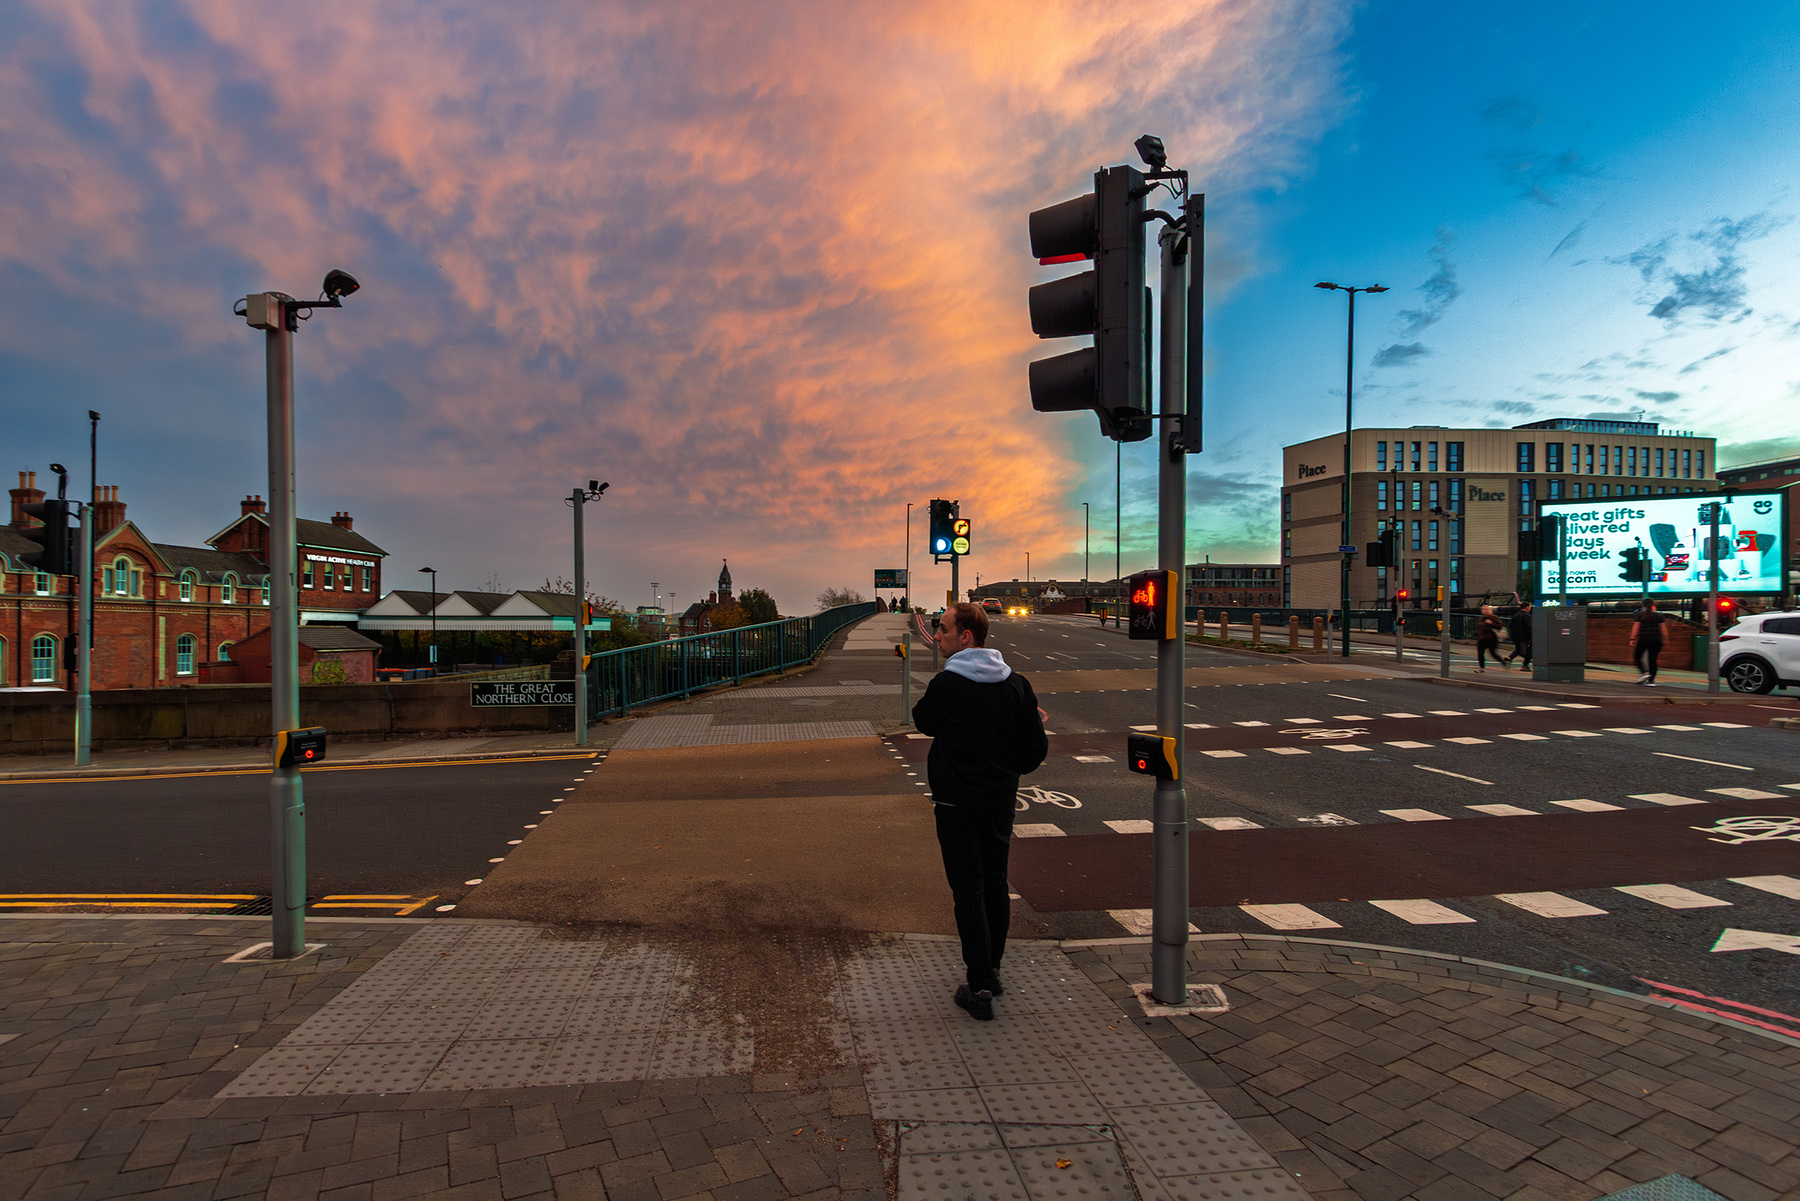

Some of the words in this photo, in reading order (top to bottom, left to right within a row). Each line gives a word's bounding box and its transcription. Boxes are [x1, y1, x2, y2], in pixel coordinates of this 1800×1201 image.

[1298, 465, 1327, 479] Place
[1469, 486, 1506, 501] Place
[1602, 507, 1646, 523] gifts
[306, 554, 328, 562] VIRGIN
[328, 556, 347, 564] ACTIVE
[1566, 548, 1612, 560] week
[1548, 576, 1597, 584] aocom
[493, 684, 516, 694] THE
[520, 683, 556, 694] GREAT
[476, 693, 537, 704] NORTHERN
[540, 693, 574, 704] CLOSE
